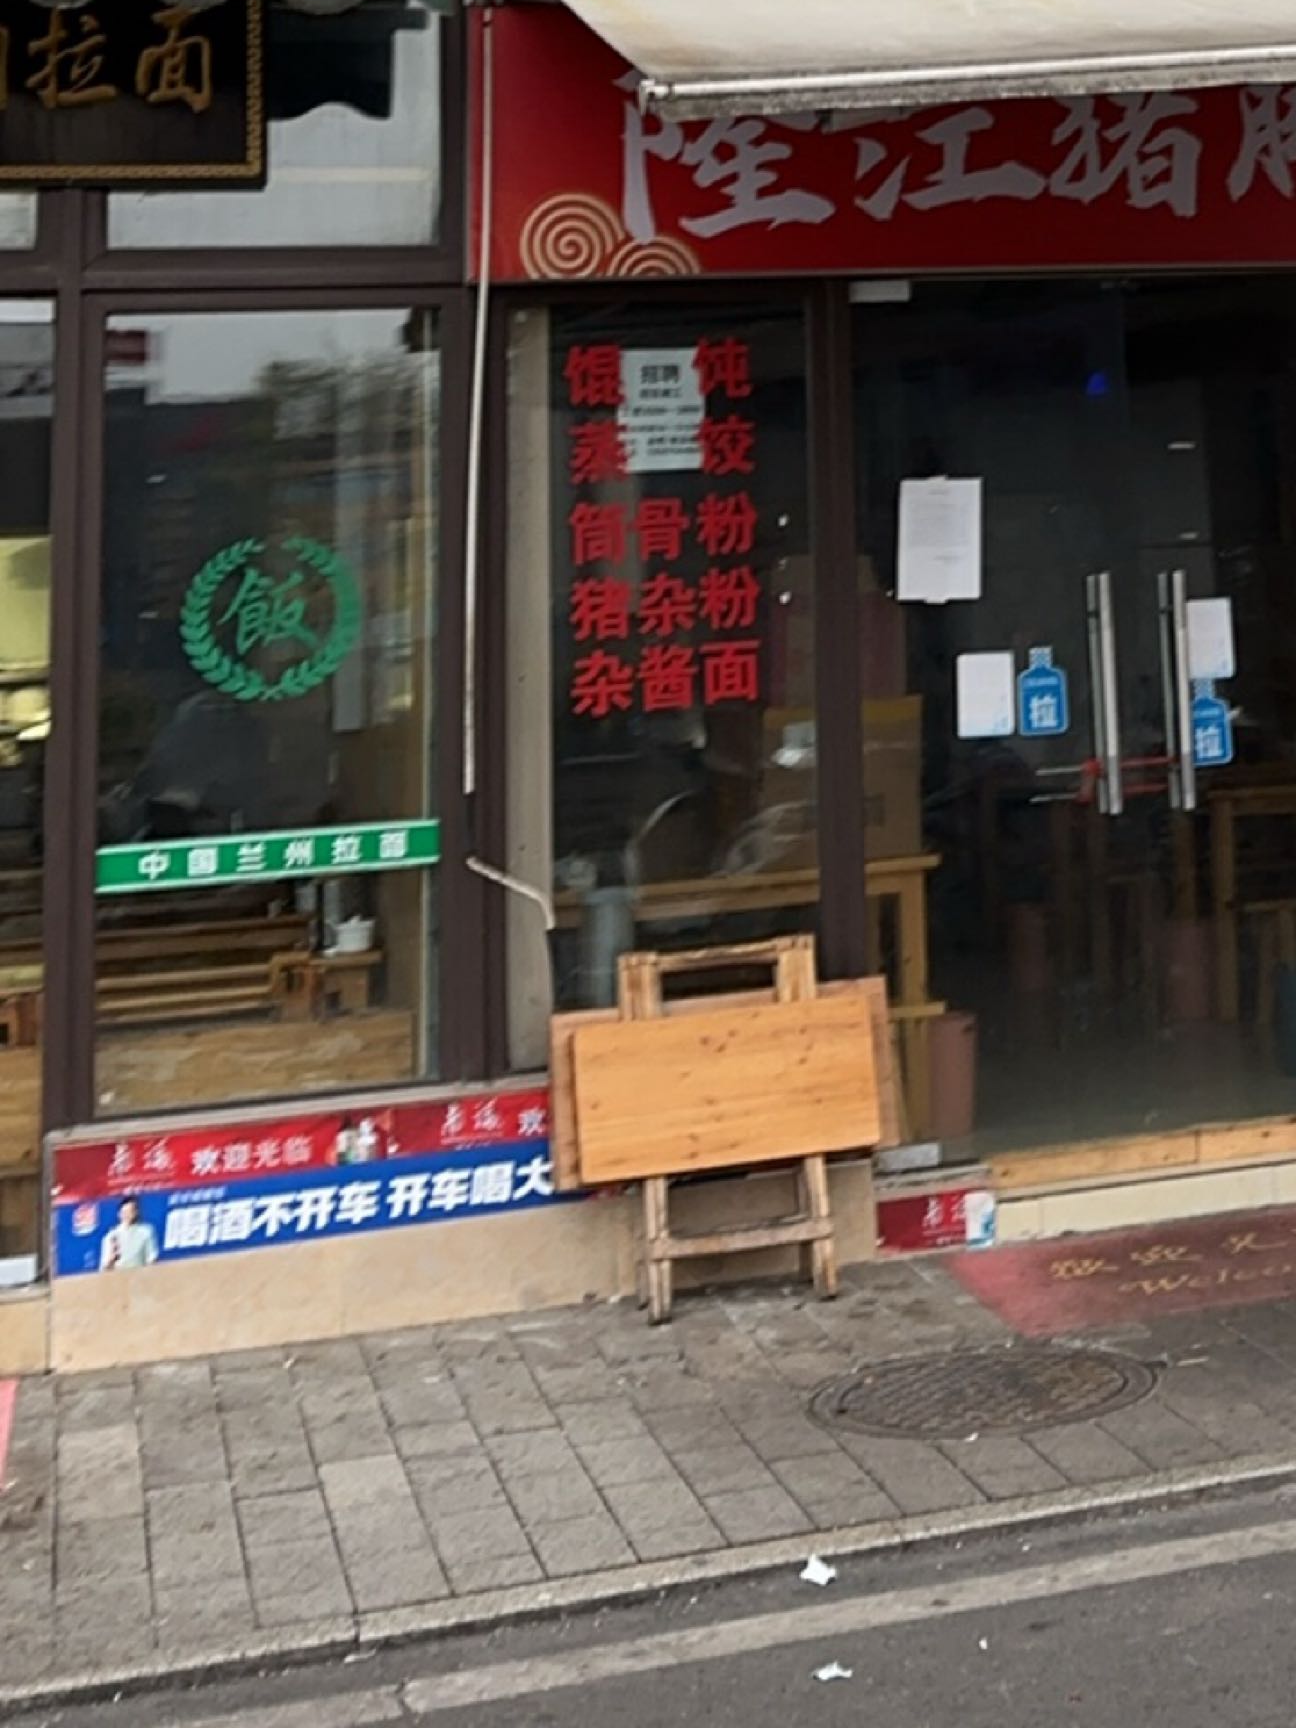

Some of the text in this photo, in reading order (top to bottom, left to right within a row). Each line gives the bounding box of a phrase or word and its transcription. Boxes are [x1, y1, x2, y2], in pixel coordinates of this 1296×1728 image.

[0, 7, 212, 113] 拉面
[564, 337, 753, 406] 馄饨
[569, 416, 755, 483] 蒸饺
[569, 490, 758, 566] 筒骨粉
[571, 566, 759, 641] 猪杂粉
[571, 640, 761, 717] 杂酱面
[190, 1136, 313, 1176] 欢迎光临
[164, 1180, 381, 1250] 喝酒不开车
[386, 1157, 554, 1218] 开车喝大
